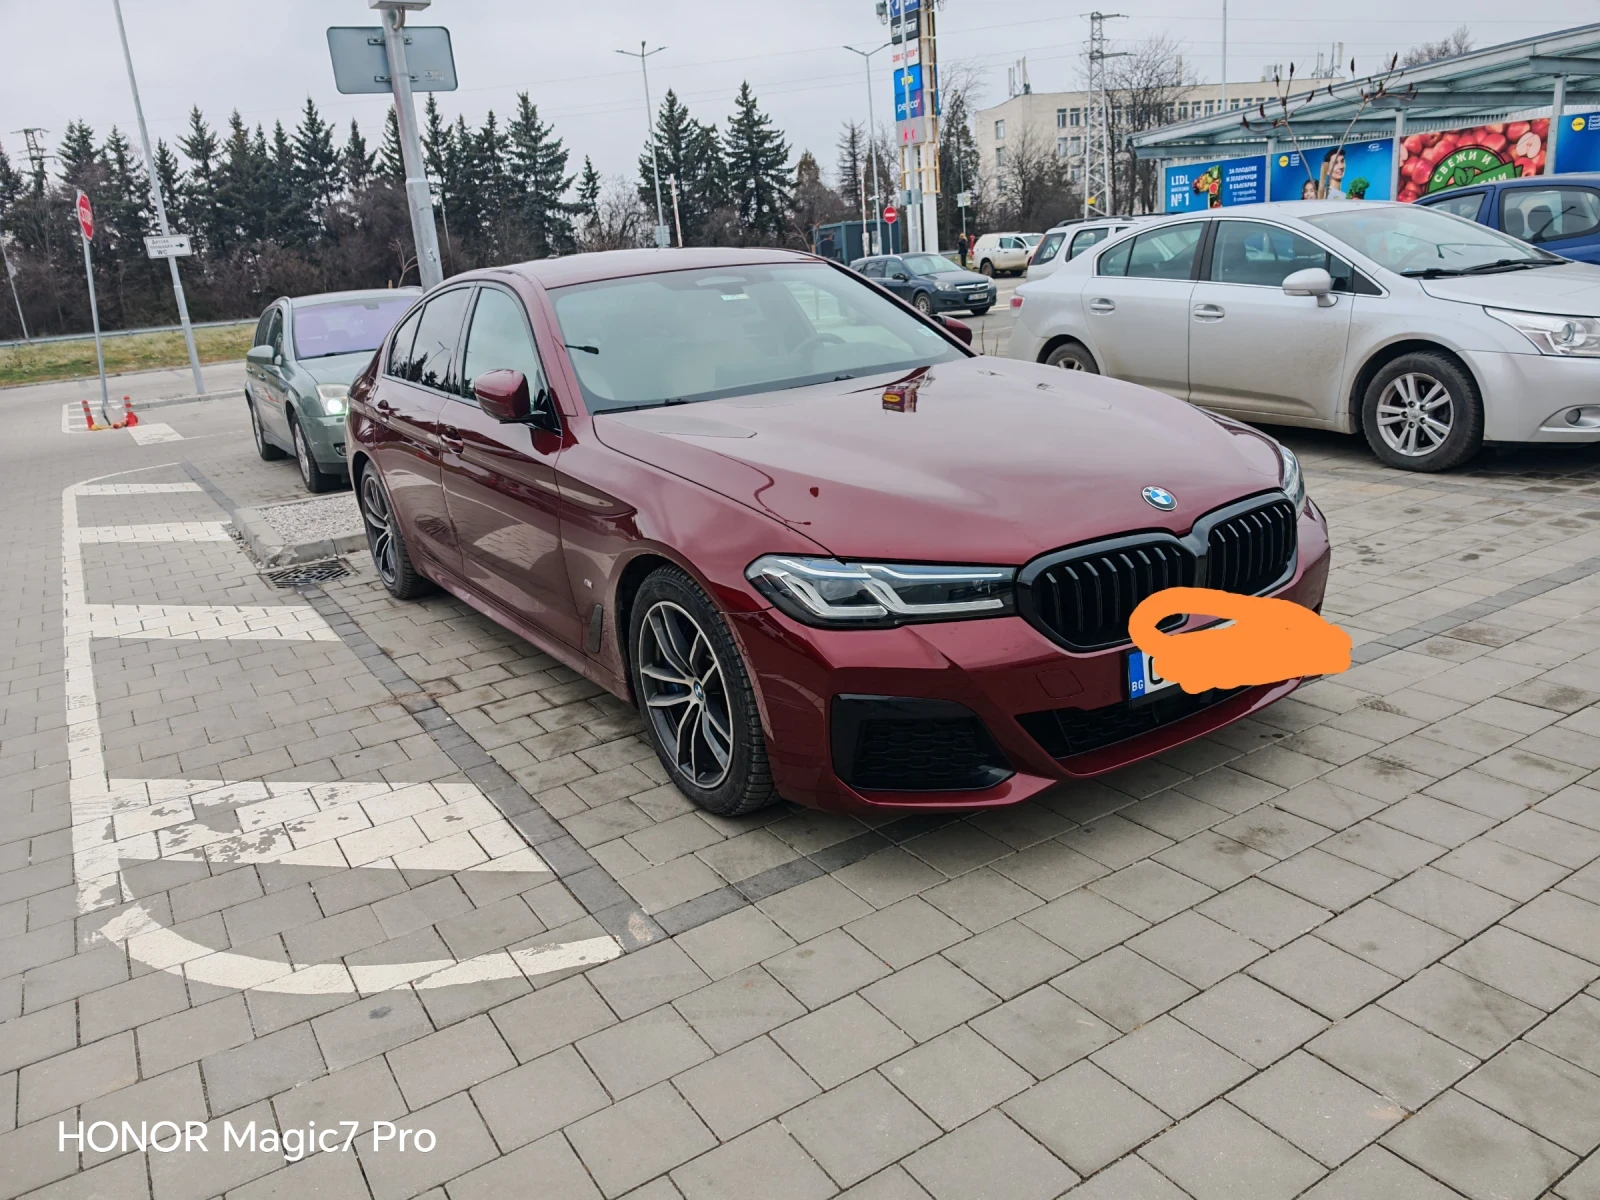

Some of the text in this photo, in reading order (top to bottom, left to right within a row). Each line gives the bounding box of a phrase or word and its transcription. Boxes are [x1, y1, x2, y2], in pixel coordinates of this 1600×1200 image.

[897, 100, 918, 114] peco
[1434, 151, 1492, 183] СВЕЖИ И
[1171, 175, 1190, 186] LIDL
[1131, 680, 1144, 692] BG
